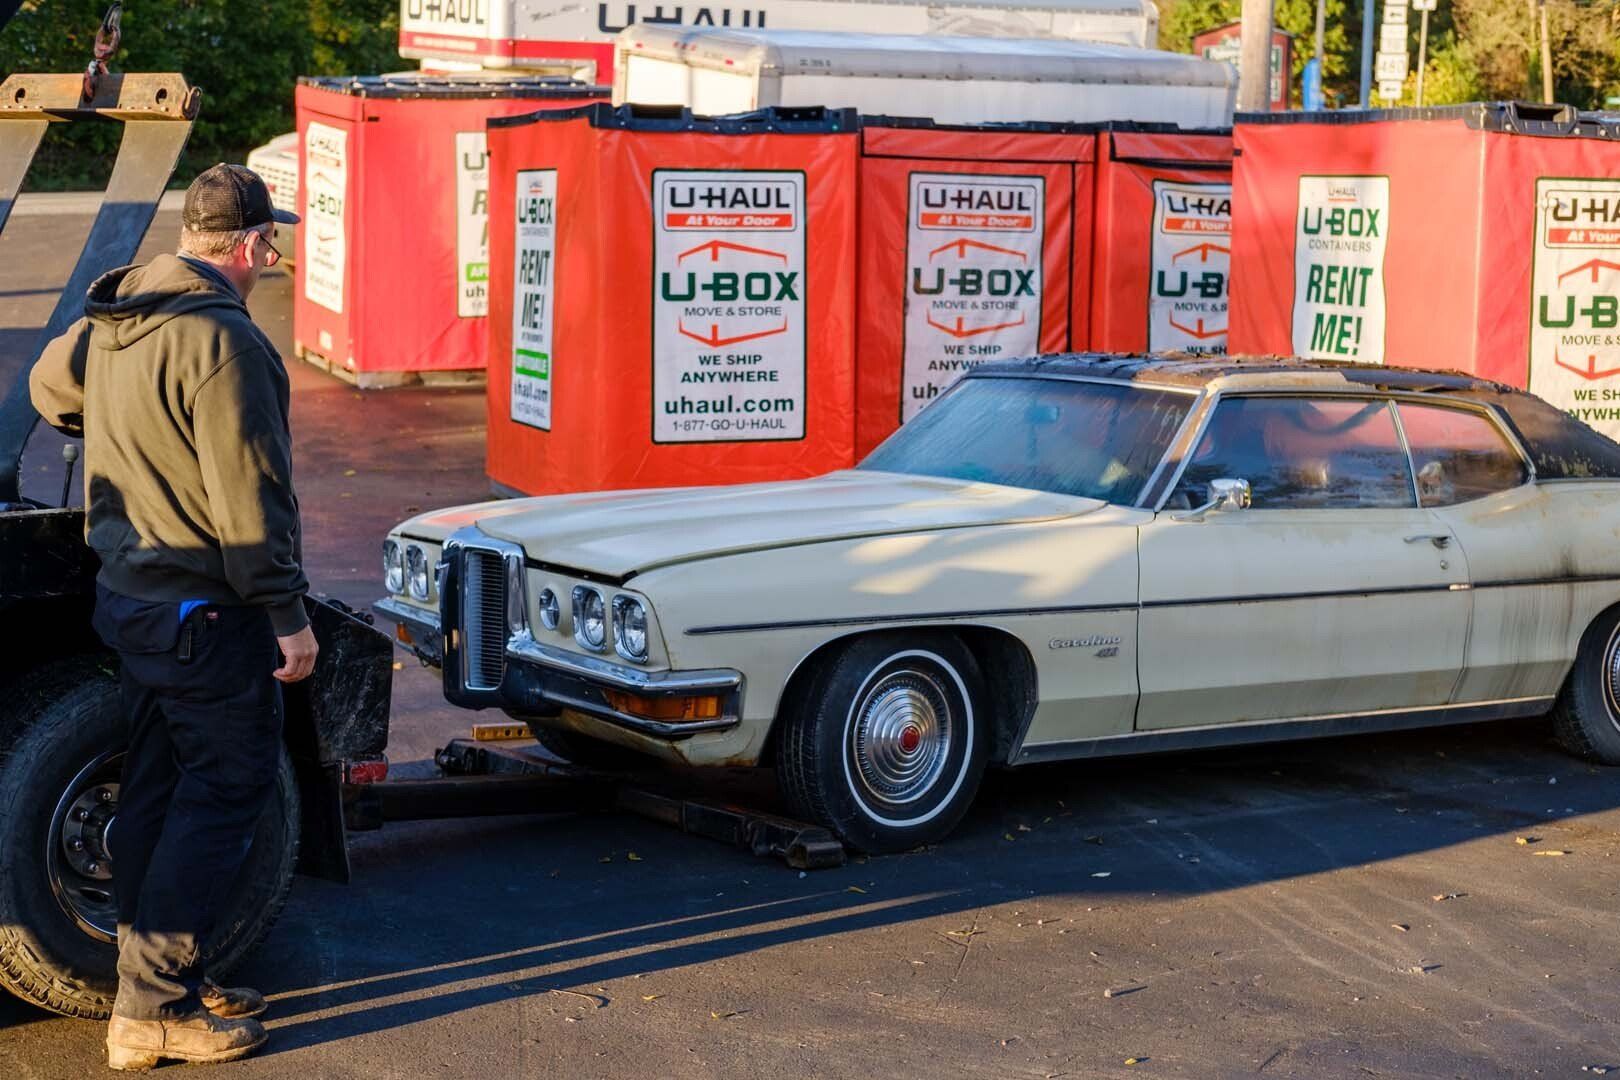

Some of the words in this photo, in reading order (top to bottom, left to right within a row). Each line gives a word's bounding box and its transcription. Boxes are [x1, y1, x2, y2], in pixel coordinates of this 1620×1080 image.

[408, 0, 485, 24] U-HAUL
[669, 186, 790, 208] U-HAUL
[924, 188, 1031, 211] U-HAUL
[518, 198, 553, 224] U-BOX
[685, 215, 704, 225] At
[706, 215, 741, 226] Your
[742, 215, 780, 226] Door
[938, 215, 953, 225] At
[956, 216, 986, 227] Your
[988, 217, 1020, 228] Door
[1181, 219, 1196, 230] At
[1199, 220, 1226, 231] Your
[1303, 207, 1380, 238] U-BOX
[1567, 229, 1584, 242] At
[1308, 239, 1372, 252] CONTAINERS
[519, 249, 551, 286] RENT
[662, 271, 799, 301] U-BOX
[913, 267, 1036, 297] U-BOX
[1157, 270, 1229, 298] U-B
[1306, 263, 1374, 308] RENT
[521, 292, 545, 329] ME!
[685, 306, 723, 317] MOVE
[725, 306, 736, 316] &
[738, 306, 782, 316] STORE
[932, 300, 969, 311] MOVE
[971, 301, 979, 310] &
[981, 301, 1019, 311] STORE
[1174, 302, 1208, 313] MOVE
[1211, 303, 1219, 313] &
[1310, 312, 1363, 356] ME!
[1561, 335, 1601, 345] MOVE
[1604, 335, 1614, 345] &
[943, 345, 965, 355] WE
[969, 345, 1003, 356] SHIP
[698, 355, 723, 365] WE
[726, 354, 763, 365] SHIP
[681, 370, 779, 383] ANYWHERE
[1573, 389, 1598, 401] WE
[665, 394, 795, 414] uhaul.com
[673, 418, 786, 432] 1-877-GO-U-HAUL
[1048, 635, 1121, 650] Catalina
